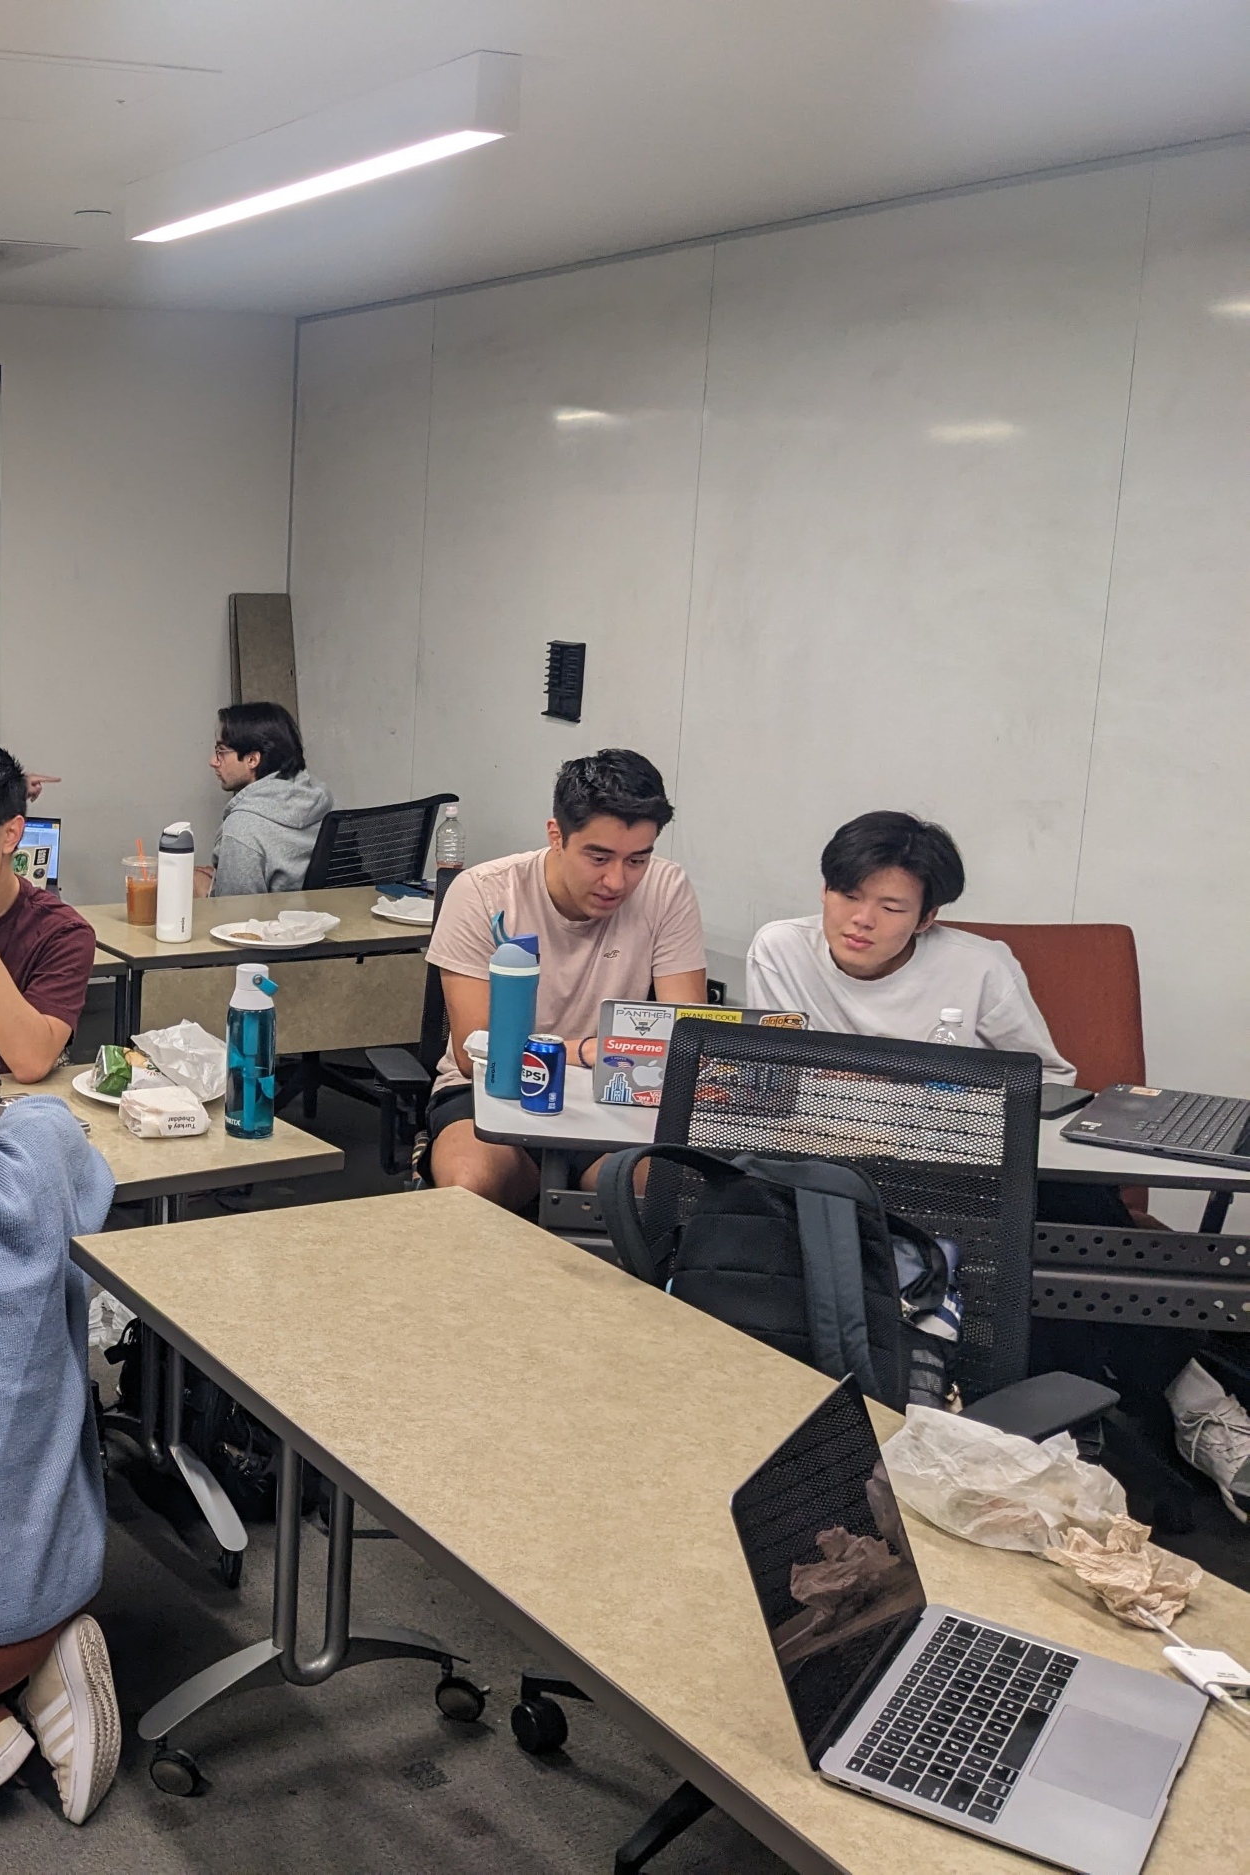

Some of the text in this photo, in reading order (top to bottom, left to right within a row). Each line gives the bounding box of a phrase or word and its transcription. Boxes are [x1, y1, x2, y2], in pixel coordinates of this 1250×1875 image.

[616, 1009, 672, 1020] PANTHER
[680, 1012, 706, 1020] RYAN
[715, 1013, 739, 1022] COOL
[607, 1039, 663, 1053] Supreme
[522, 1068, 546, 1082] EPSI
